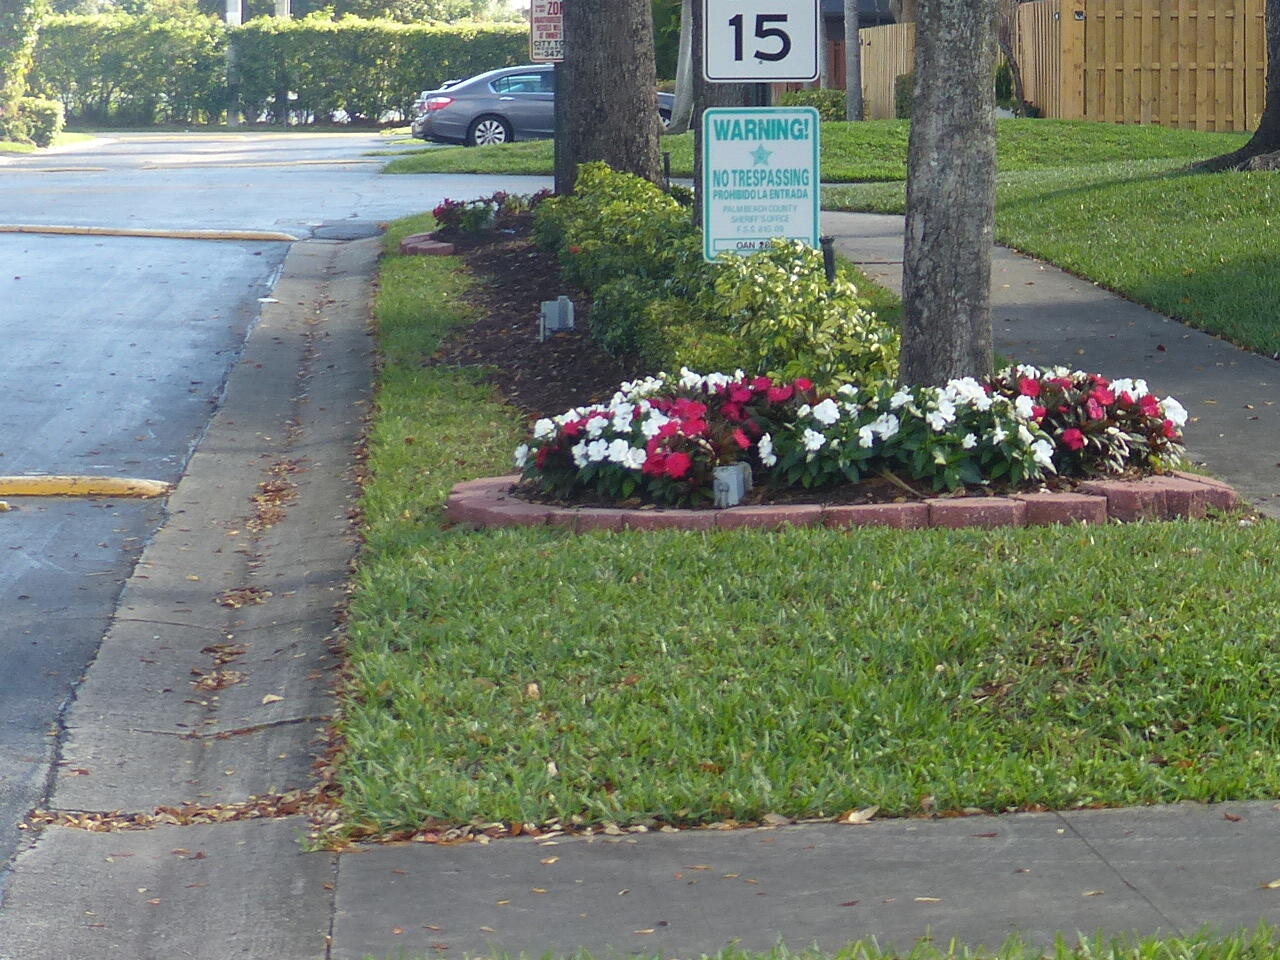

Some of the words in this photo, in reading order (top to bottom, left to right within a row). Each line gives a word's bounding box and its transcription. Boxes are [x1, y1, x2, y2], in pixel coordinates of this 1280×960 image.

[547, 2, 564, 15] ZO
[728, 13, 792, 62] 15
[713, 118, 809, 140] WARNING!
[713, 170, 729, 187] NO
[731, 168, 809, 187] TRESPASSING
[713, 189, 756, 201] PROHIBIDO
[757, 189, 768, 200] LA
[769, 188, 809, 200] ENTRADA
[768, 204, 798, 213] COUNTY
